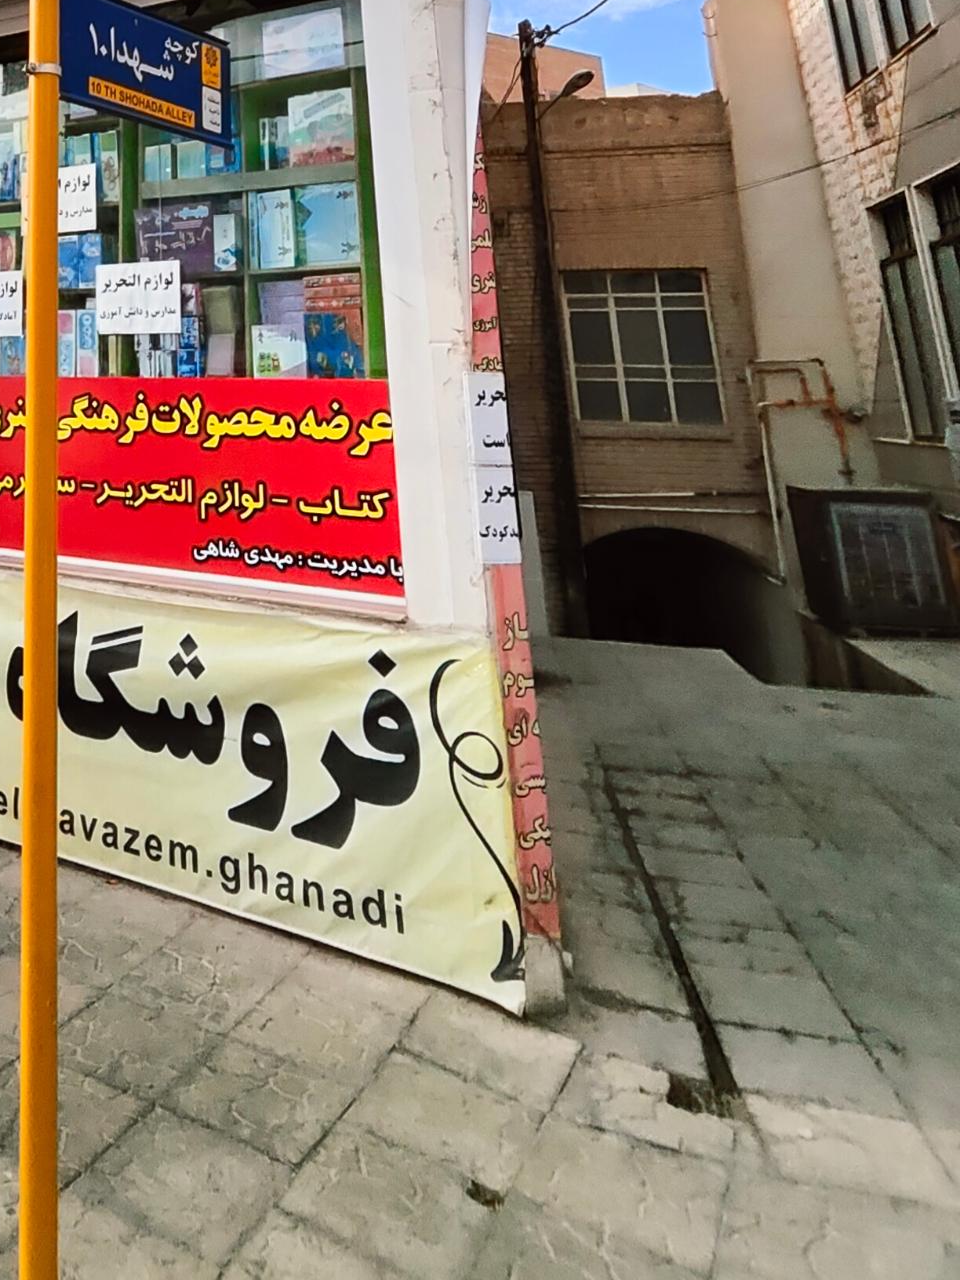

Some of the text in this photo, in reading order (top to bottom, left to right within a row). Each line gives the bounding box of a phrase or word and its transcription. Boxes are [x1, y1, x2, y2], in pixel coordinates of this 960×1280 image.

[89, 23, 175, 82] شهدا ۱۰
[164, 36, 200, 65] کوچه
[91, 81, 102, 95] 10
[104, 85, 117, 99] TH
[119, 89, 164, 114] SHOHADA
[166, 103, 193, 123] ALLEY
[64, 173, 91, 194] لوازم
[101, 272, 174, 294] لوازم التحریر
[56, 393, 149, 443] فرهنگی
[151, 396, 296, 448] محصولات
[299, 400, 393, 456] عرضه
[96, 478, 193, 507] التحریر
[200, 482, 265, 520] لوازم
[298, 488, 390, 521] کتاب
[193, 539, 240, 561] شاهی
[244, 546, 294, 569] مهدی
[308, 553, 384, 576] مدیریت
